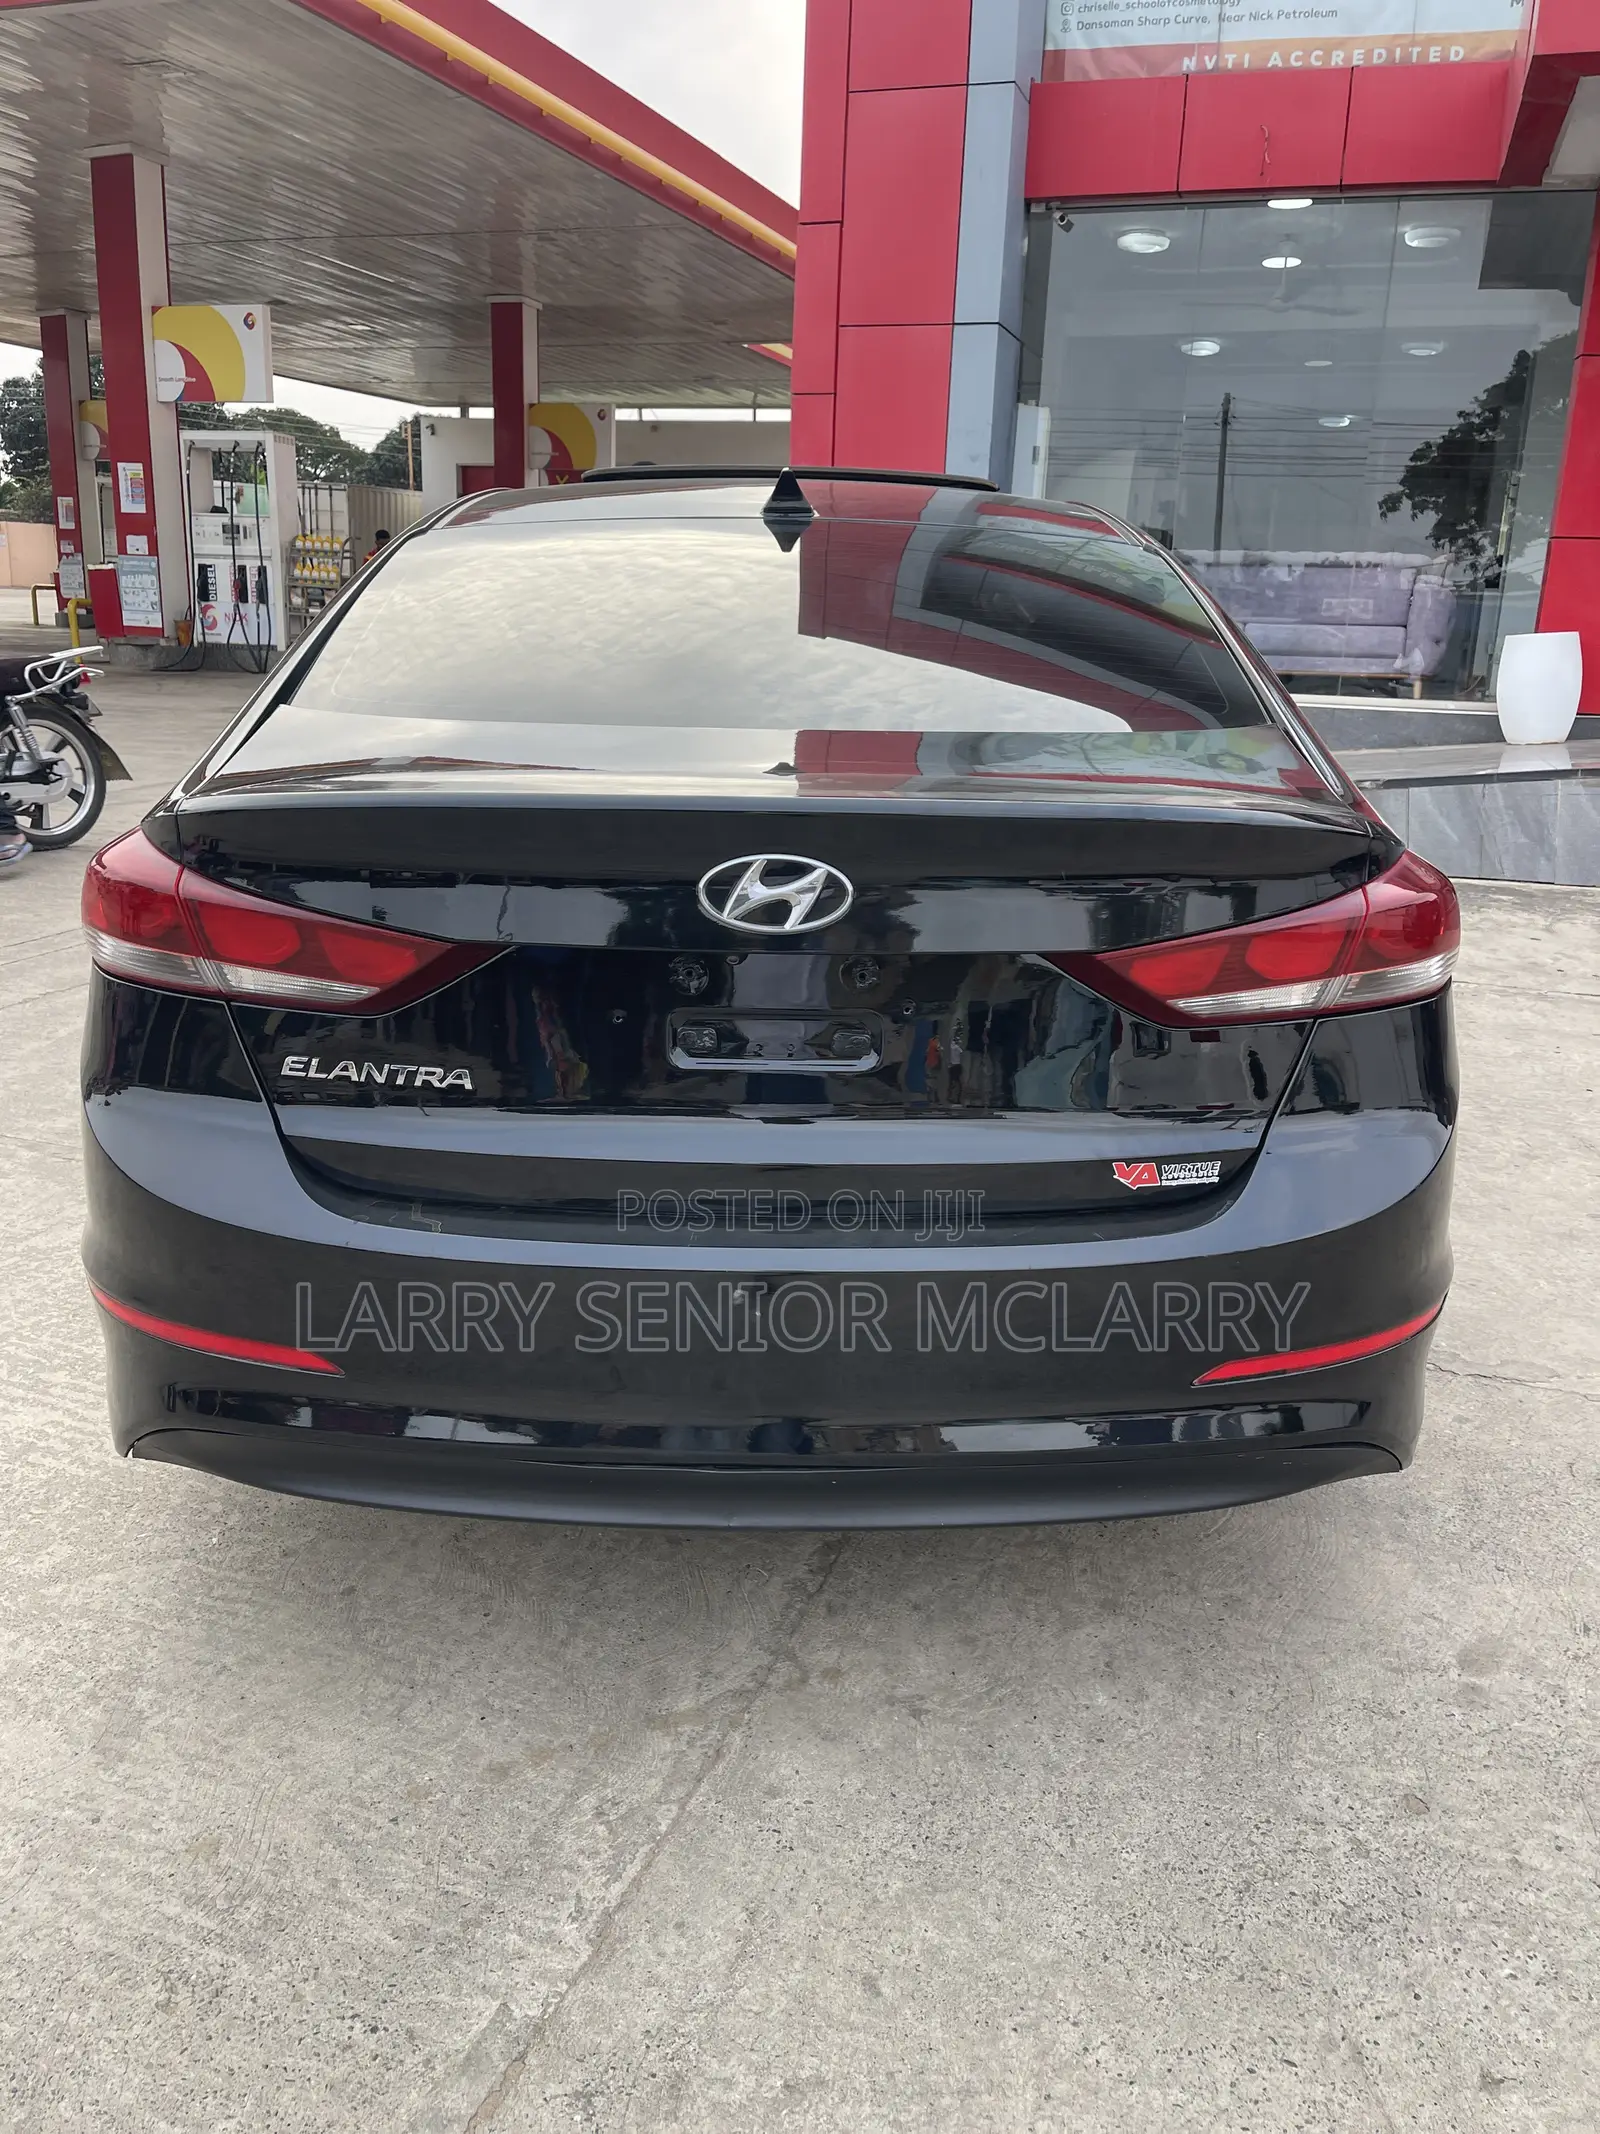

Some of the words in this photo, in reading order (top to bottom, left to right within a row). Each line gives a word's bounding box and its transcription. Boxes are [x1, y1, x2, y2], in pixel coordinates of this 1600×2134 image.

[1137, 15, 1171, 28] Sharp
[1174, 14, 1211, 25] Curve,
[1218, 12, 1246, 23] Near
[1248, 10, 1273, 21] Nick
[1277, 8, 1338, 20] Petroleum
[1181, 52, 1250, 72] NVTI
[1266, 44, 1465, 68] ACCREDITED
[207, 564, 217, 601] DIESEL
[281, 1055, 474, 1090] ELANTRA
[1161, 1161, 1221, 1176] VIRTUE
